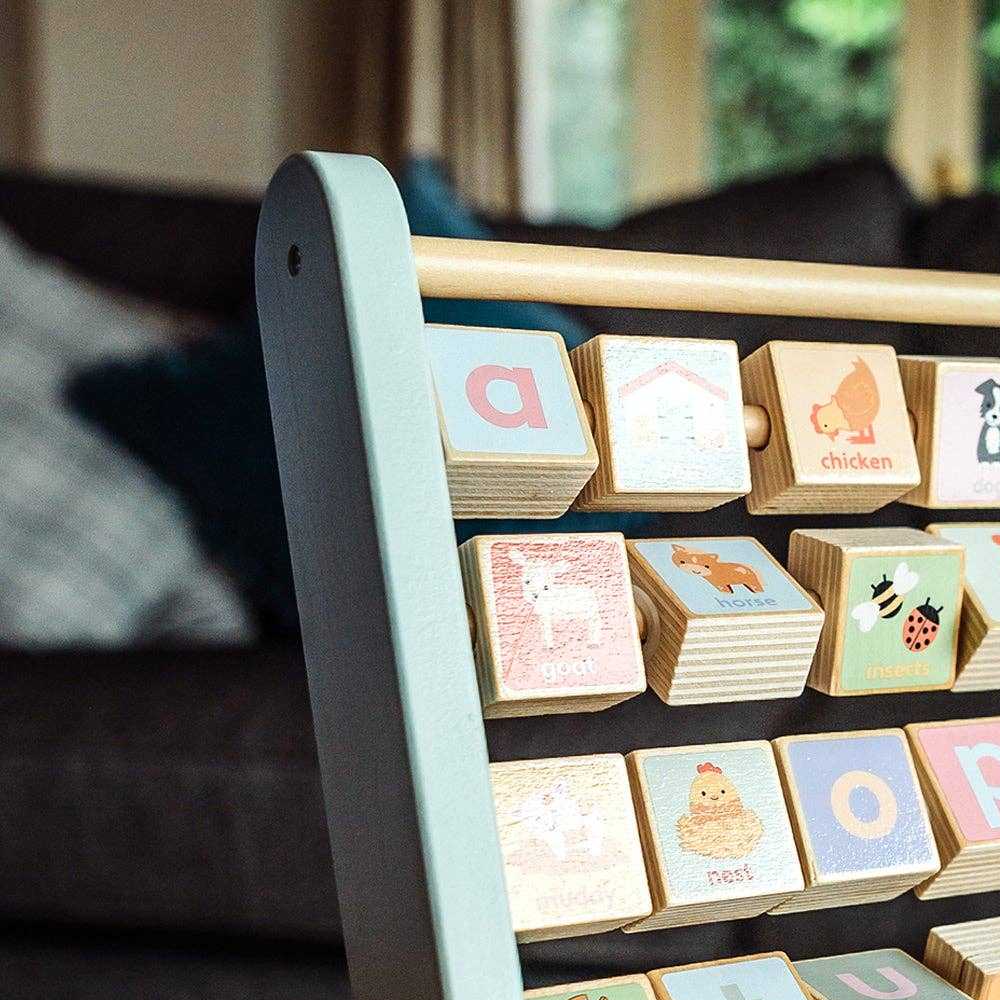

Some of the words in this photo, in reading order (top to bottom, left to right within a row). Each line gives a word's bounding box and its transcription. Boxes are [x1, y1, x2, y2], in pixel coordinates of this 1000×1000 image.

[465, 364, 549, 429] a
[820, 449, 893, 472] chicken
[716, 595, 778, 609] horse
[864, 660, 930, 680] insects
[831, 770, 897, 839] o
[706, 864, 755, 886] nest
[835, 966, 918, 1000] u
